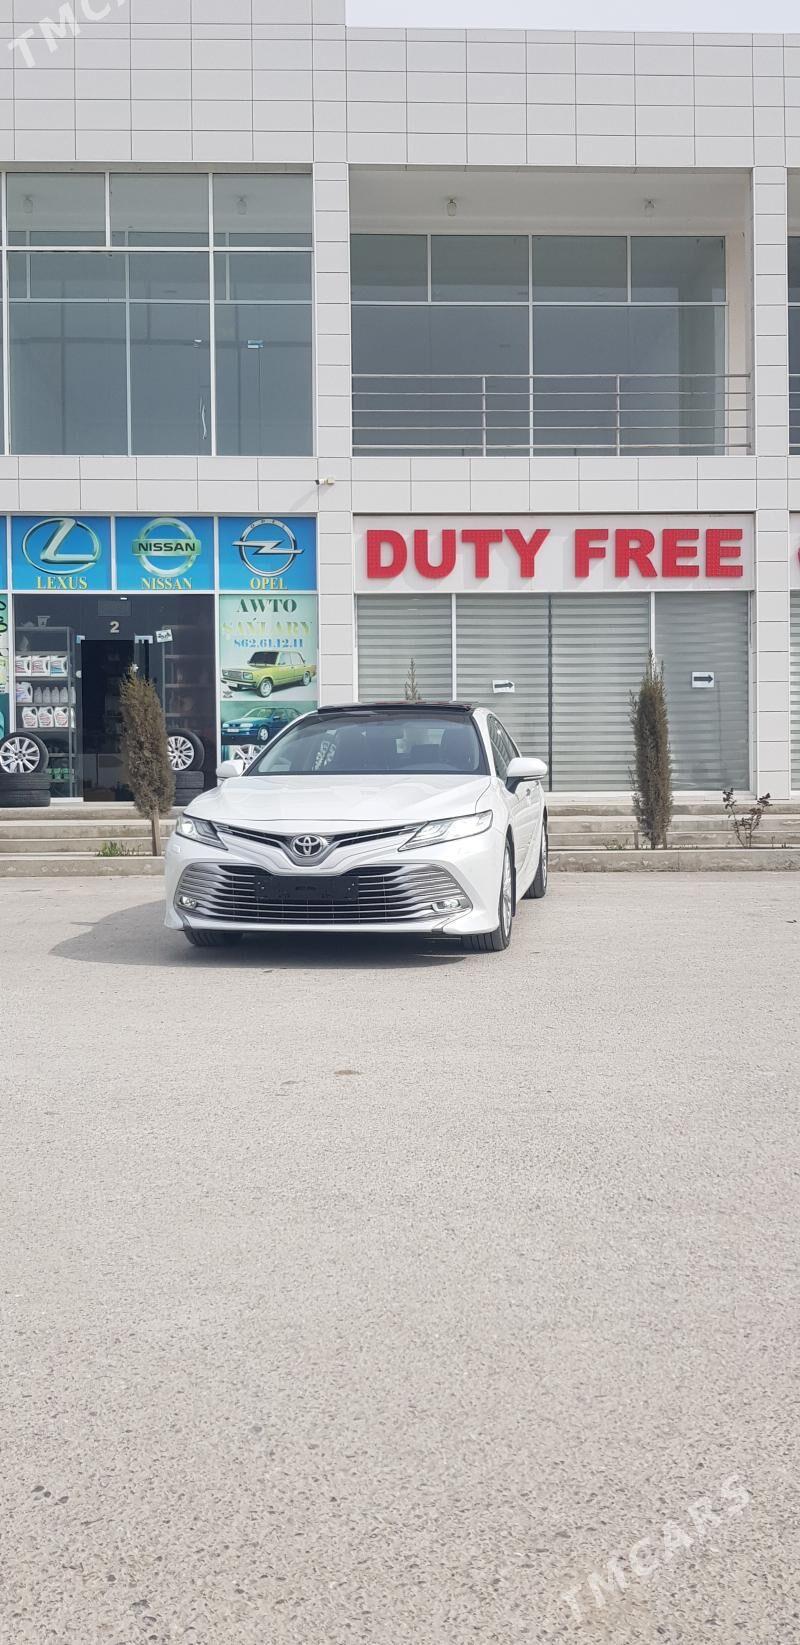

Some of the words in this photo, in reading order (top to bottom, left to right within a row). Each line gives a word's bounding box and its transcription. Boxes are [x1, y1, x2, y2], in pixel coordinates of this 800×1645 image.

[138, 542, 196, 552] NISSAN
[366, 528, 550, 579] DUTY
[575, 528, 744, 578] FREE
[36, 576, 88, 590] LEXUS
[141, 576, 193, 590] NISSAN
[249, 576, 288, 590] OPEL
[236, 598, 298, 612] AWTO
[109, 620, 120, 633] 2
